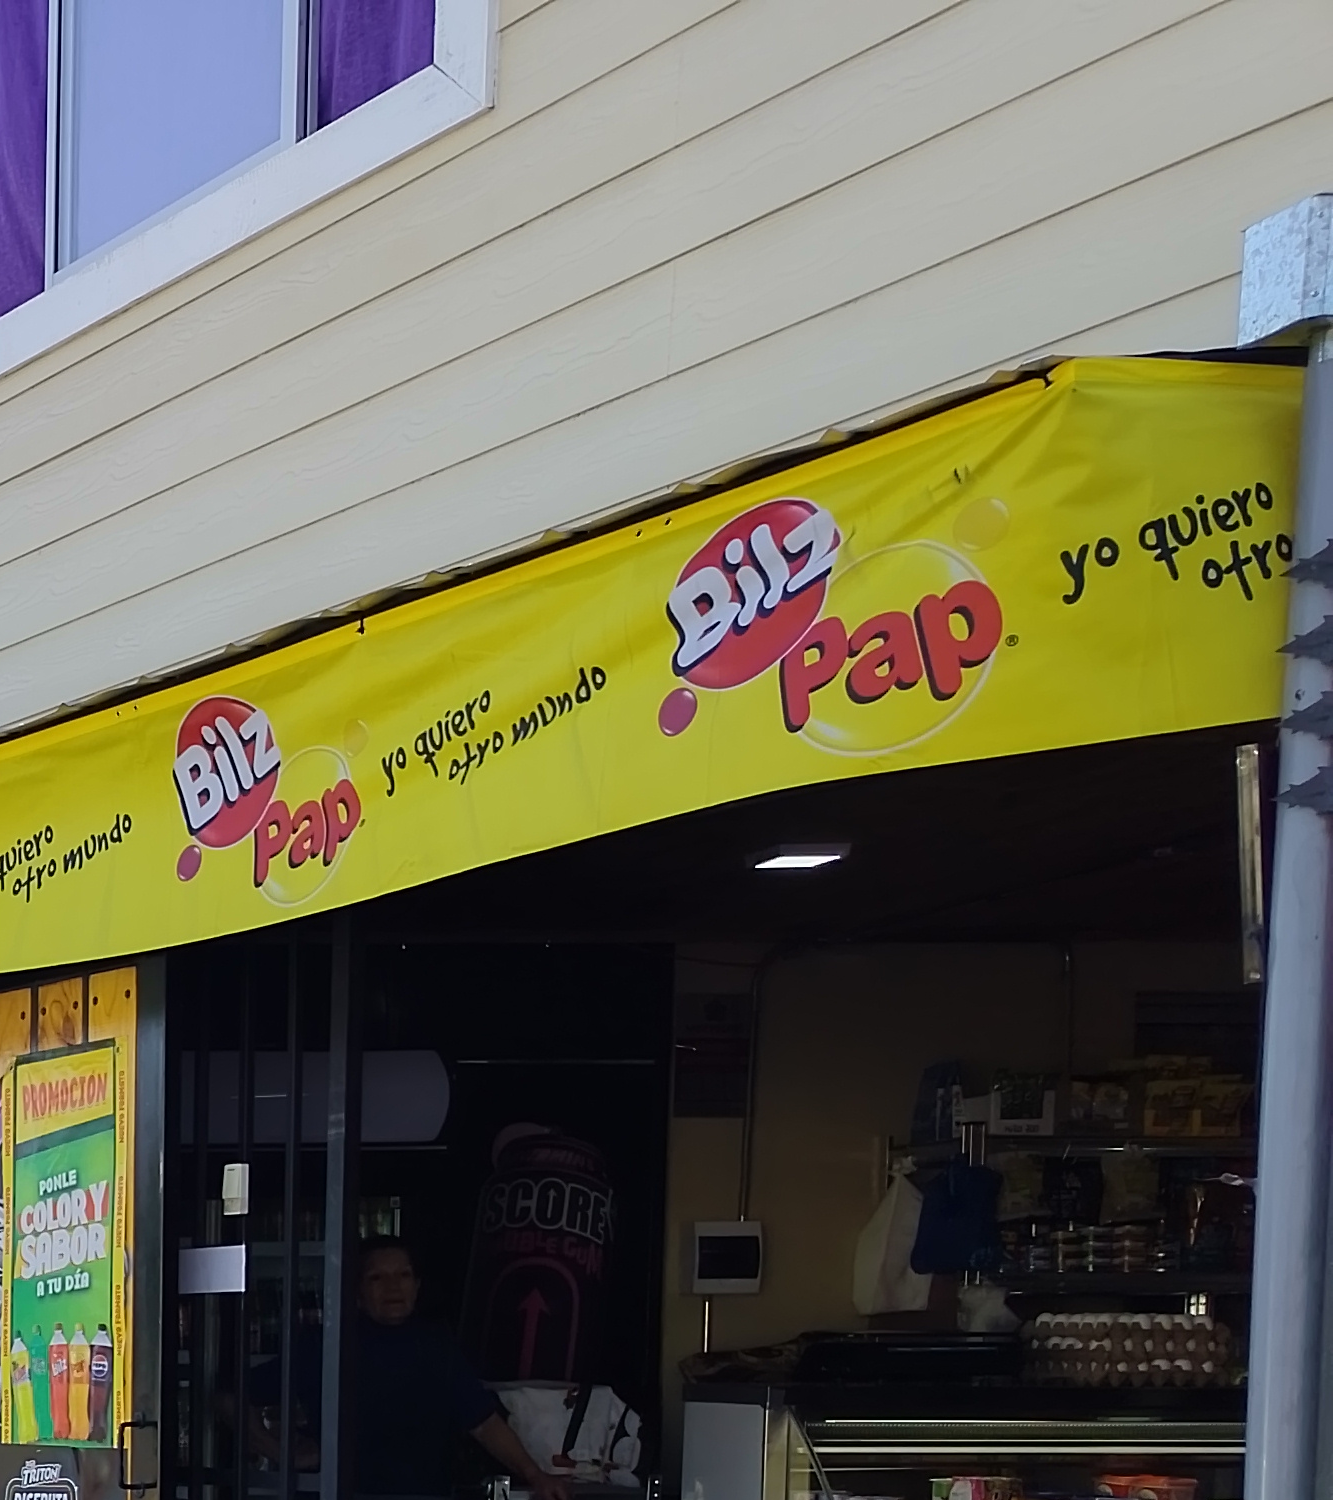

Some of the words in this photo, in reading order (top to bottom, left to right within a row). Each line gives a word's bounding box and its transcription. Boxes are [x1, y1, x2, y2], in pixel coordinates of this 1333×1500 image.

[1060, 536, 1119, 605] yo
[1139, 482, 1273, 581] quiero
[1199, 532, 1293, 601] otro
[667, 508, 841, 677] Bilz
[780, 579, 1003, 733] Pap
[381, 750, 407, 797] yo
[414, 689, 491, 778] quiero
[448, 729, 505, 785] otro
[511, 666, 607, 747] mundo
[173, 708, 281, 836] Bilz
[11, 857, 56, 903] otro
[63, 813, 132, 874] mundo
[253, 778, 362, 887] Pap
[22, 1072, 108, 1123] PROMOCIÓN
[20, 1188, 88, 1235] COLOR
[88, 1179, 109, 1222] Y
[39, 1169, 77, 1196] PONLE
[483, 1177, 605, 1245] SCORE
[20, 1223, 107, 1280] SABOR
[36, 1281, 45, 1297] A
[46, 1276, 61, 1295] TU
[65, 1268, 90, 1290] DÍA
[22, 1466, 61, 1486] TRITON
